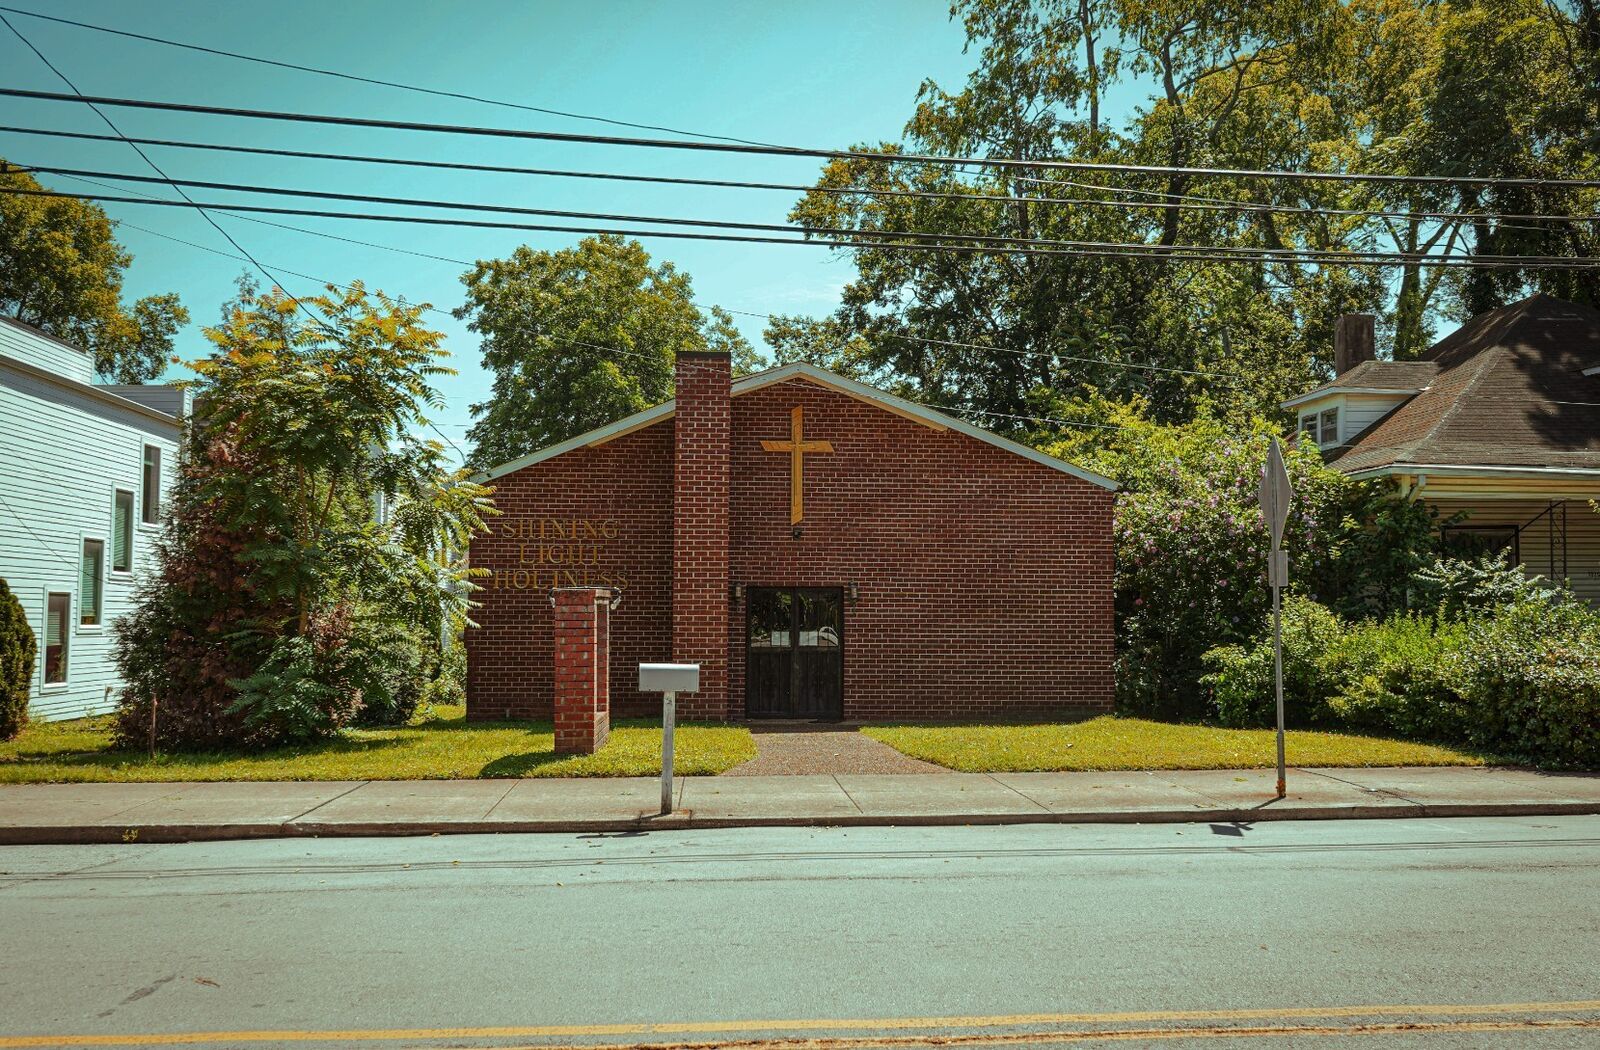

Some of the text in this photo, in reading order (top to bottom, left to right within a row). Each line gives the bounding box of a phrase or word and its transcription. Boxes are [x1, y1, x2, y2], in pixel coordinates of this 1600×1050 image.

[501, 519, 620, 539] SHINING
[519, 544, 604, 565] LIGHT
[493, 570, 630, 590] HOLINESS
